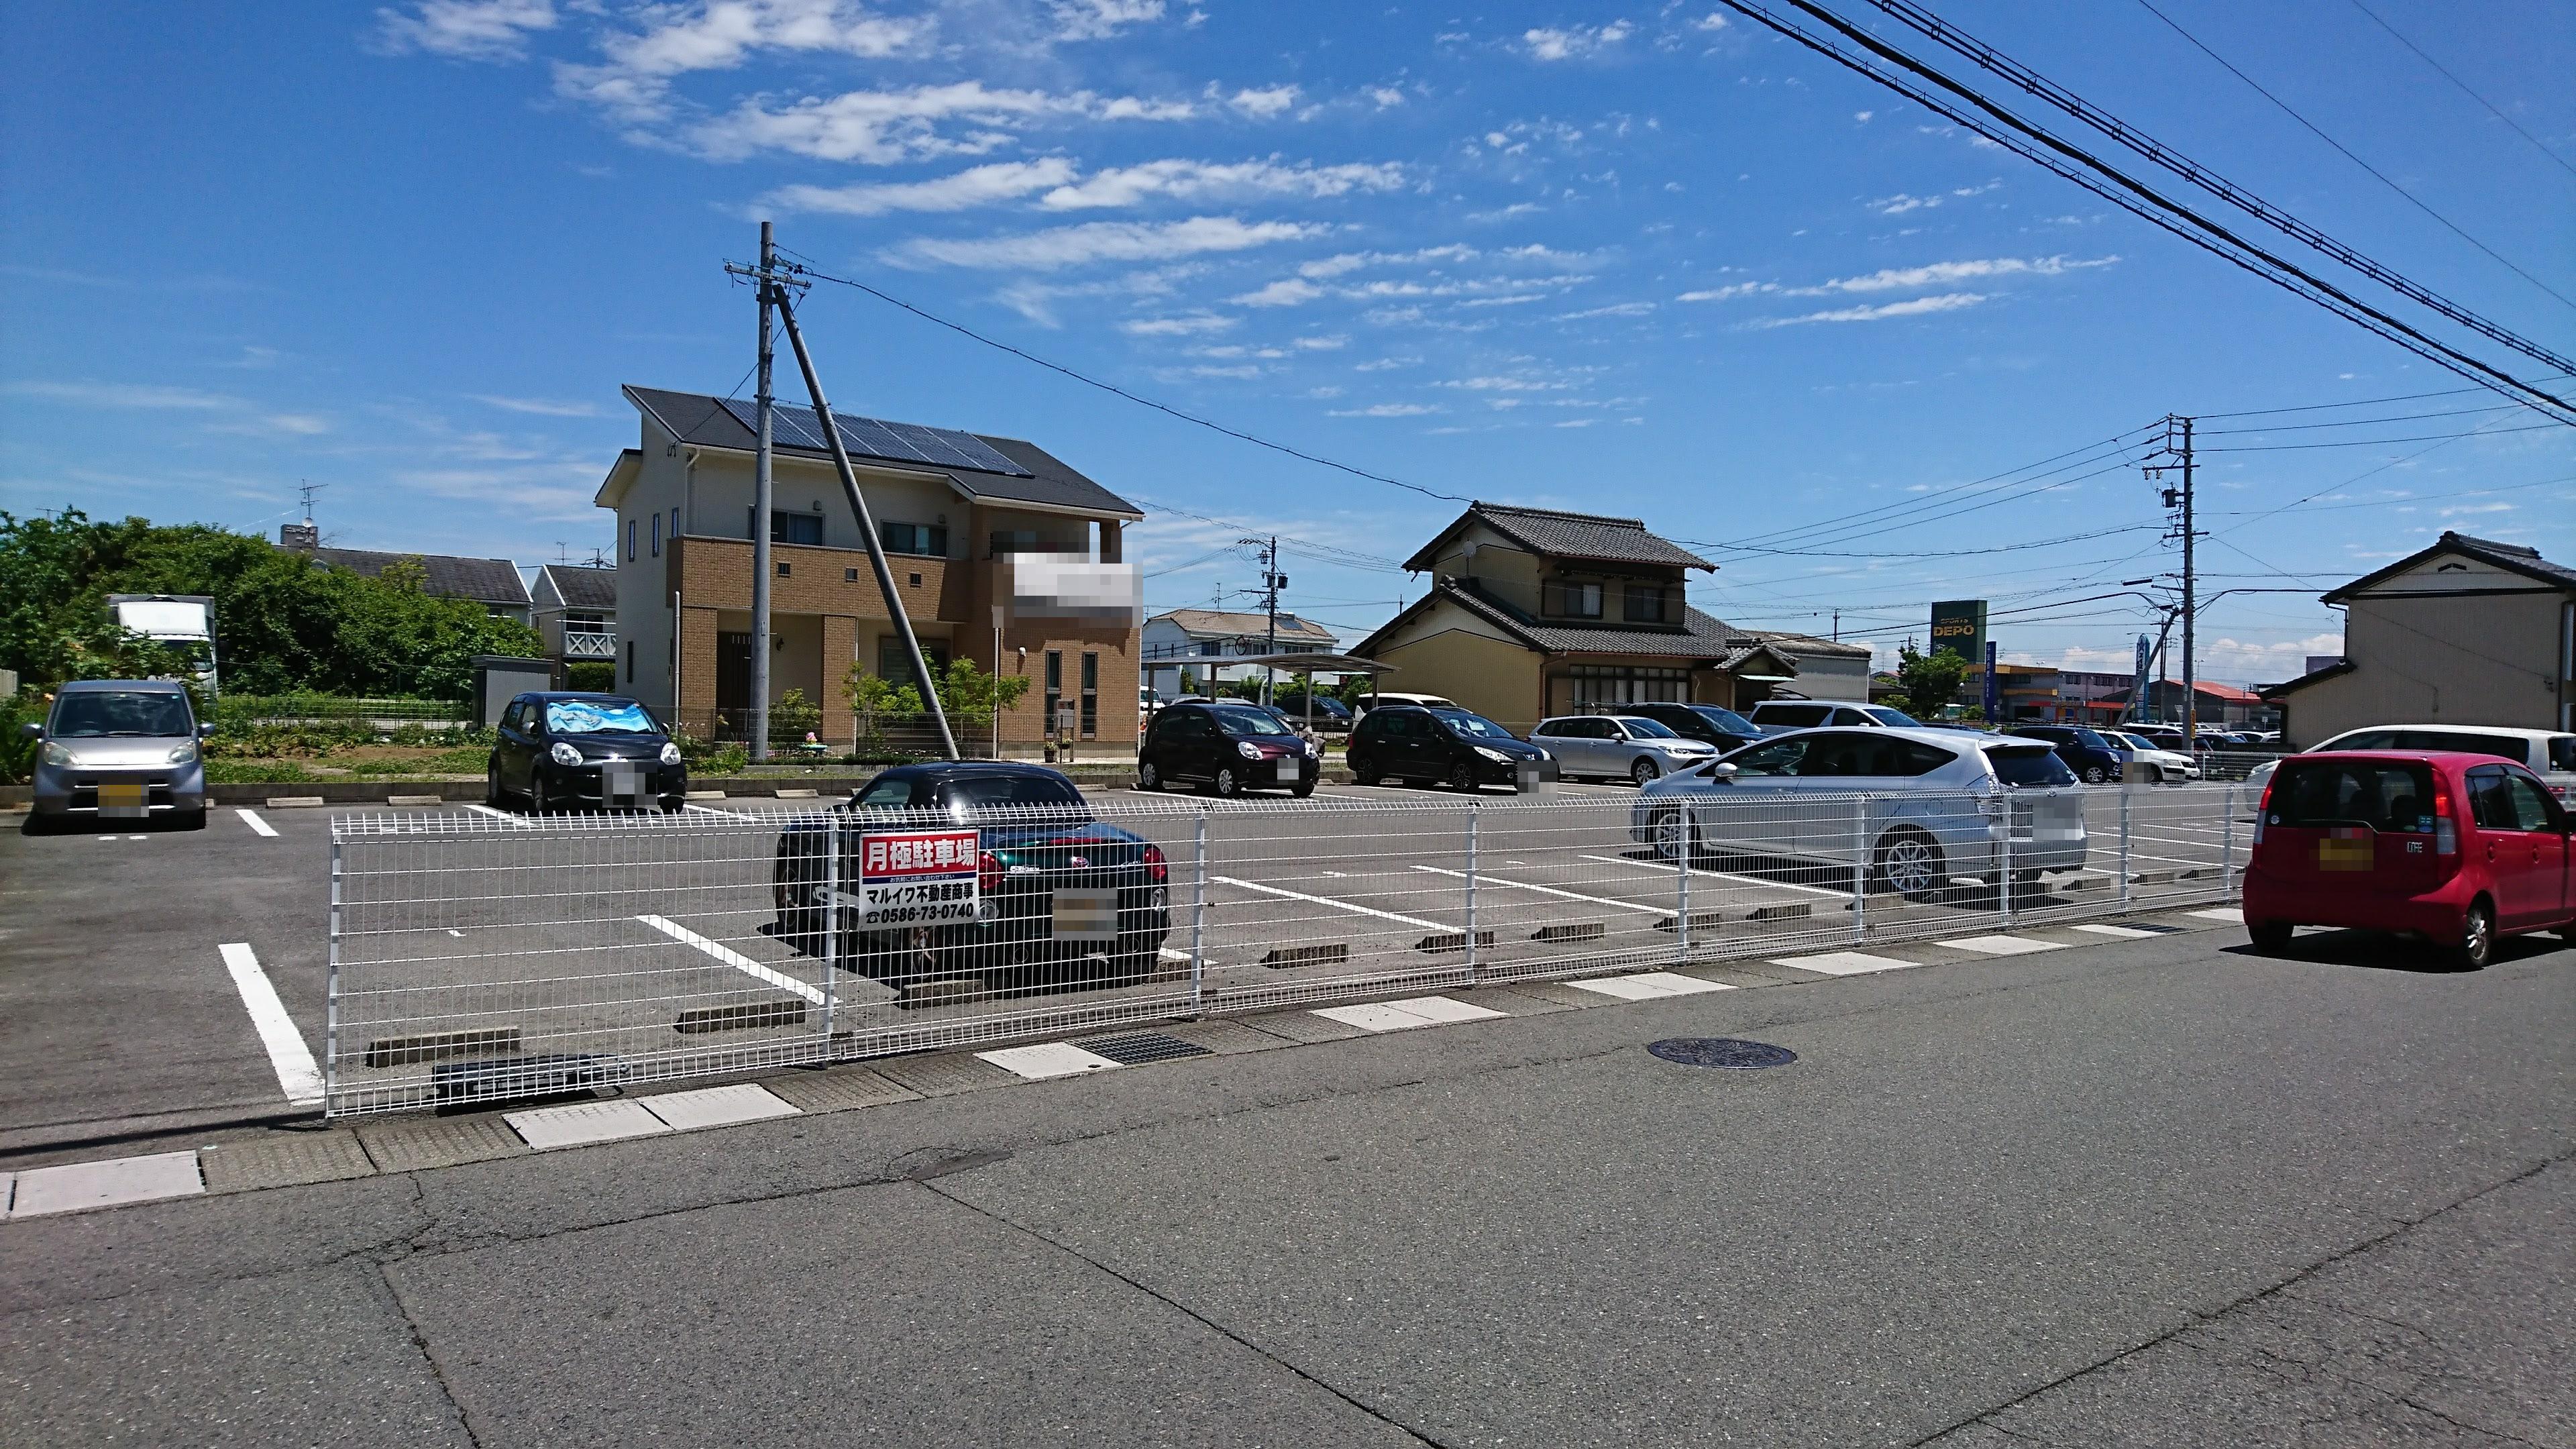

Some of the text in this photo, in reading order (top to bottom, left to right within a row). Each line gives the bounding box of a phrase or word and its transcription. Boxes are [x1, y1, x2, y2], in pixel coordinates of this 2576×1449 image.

[867, 839, 975, 871] 月極駐車場
[890, 874, 955, 883] お気軽にお問い合わせ下さい
[867, 882, 973, 904] マルイワ不動産商事
